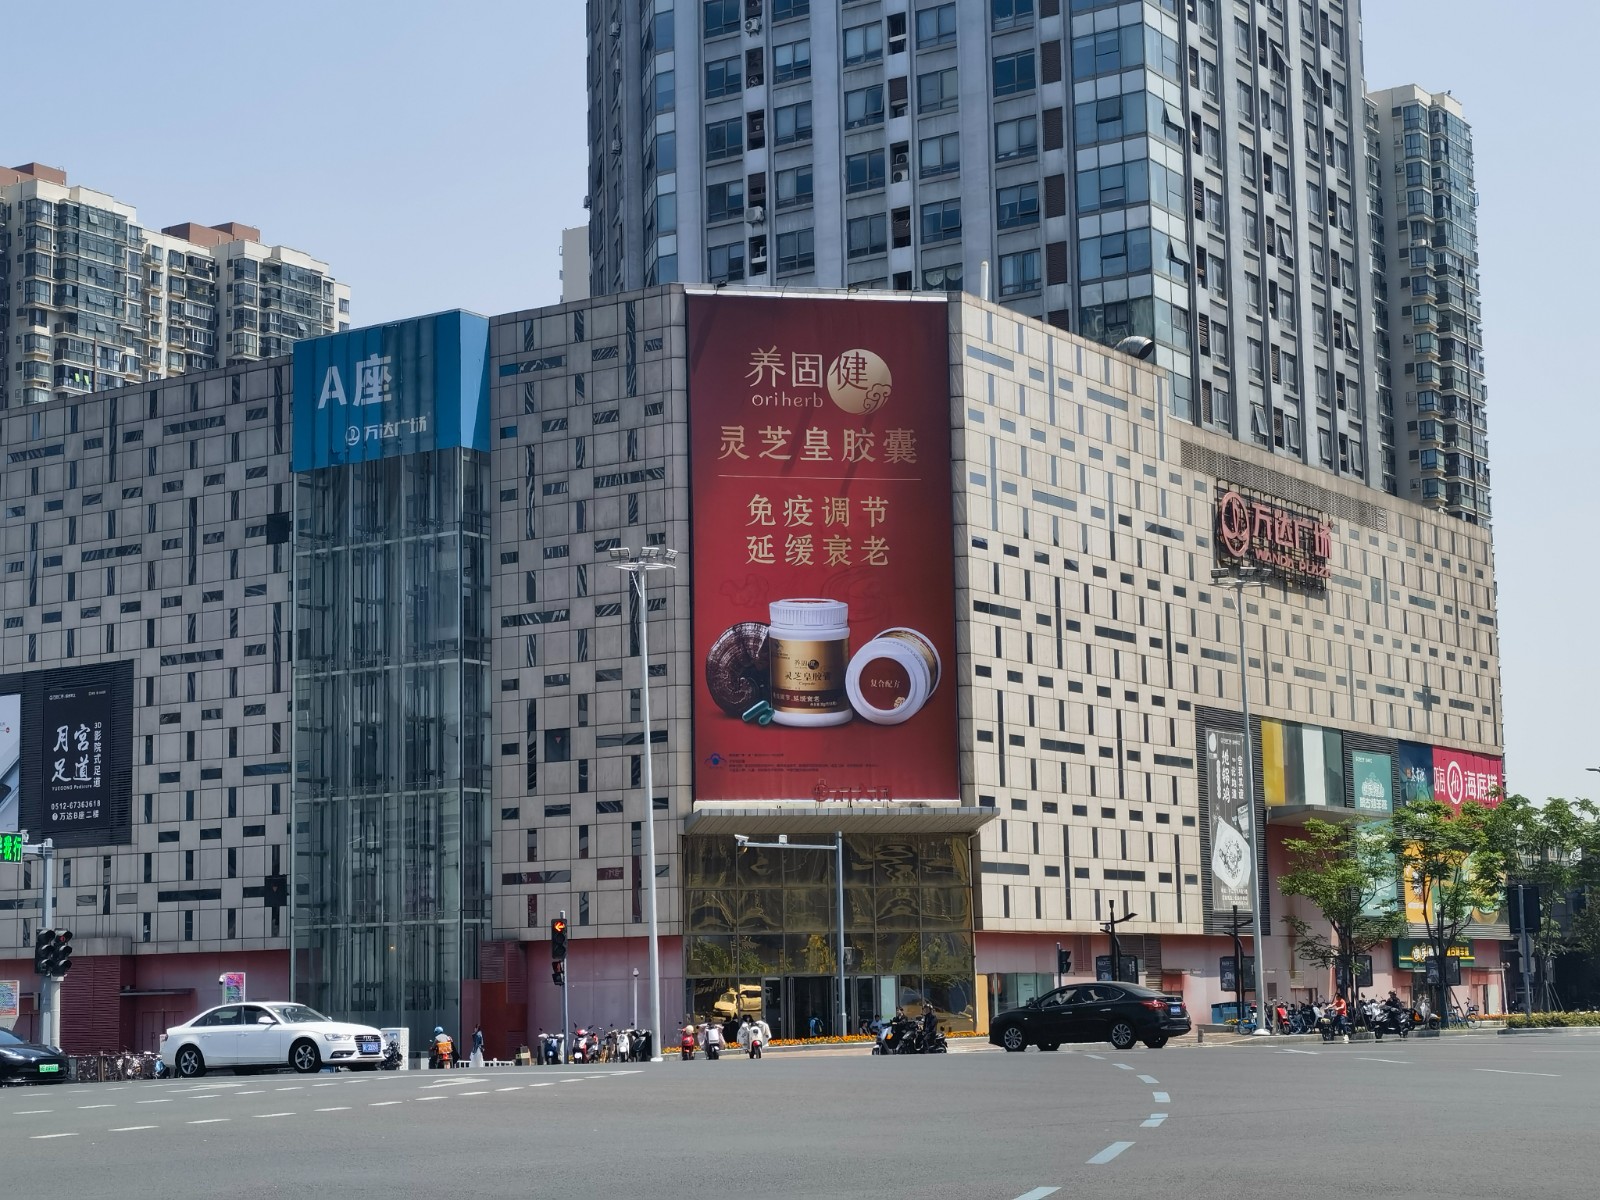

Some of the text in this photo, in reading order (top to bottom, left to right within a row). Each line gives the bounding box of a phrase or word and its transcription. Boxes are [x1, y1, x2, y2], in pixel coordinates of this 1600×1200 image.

[318, 353, 393, 410] A座
[745, 345, 868, 391] 养固健
[751, 391, 824, 409] oriherb
[364, 416, 427, 441] 万达广场
[717, 425, 918, 464] 灵芝皇胶囊
[745, 493, 890, 528] 免疫调节
[1251, 502, 1333, 560] 万达广场
[745, 534, 890, 567] 延缓衰老
[1255, 548, 1331, 578] WANDA PLAZA
[870, 679, 900, 689] 复合配方
[53, 723, 91, 752] 月宫
[51, 754, 92, 782] 足道
[93, 722, 102, 788] 3D影院式足道
[1464, 770, 1498, 803] 海底捞
